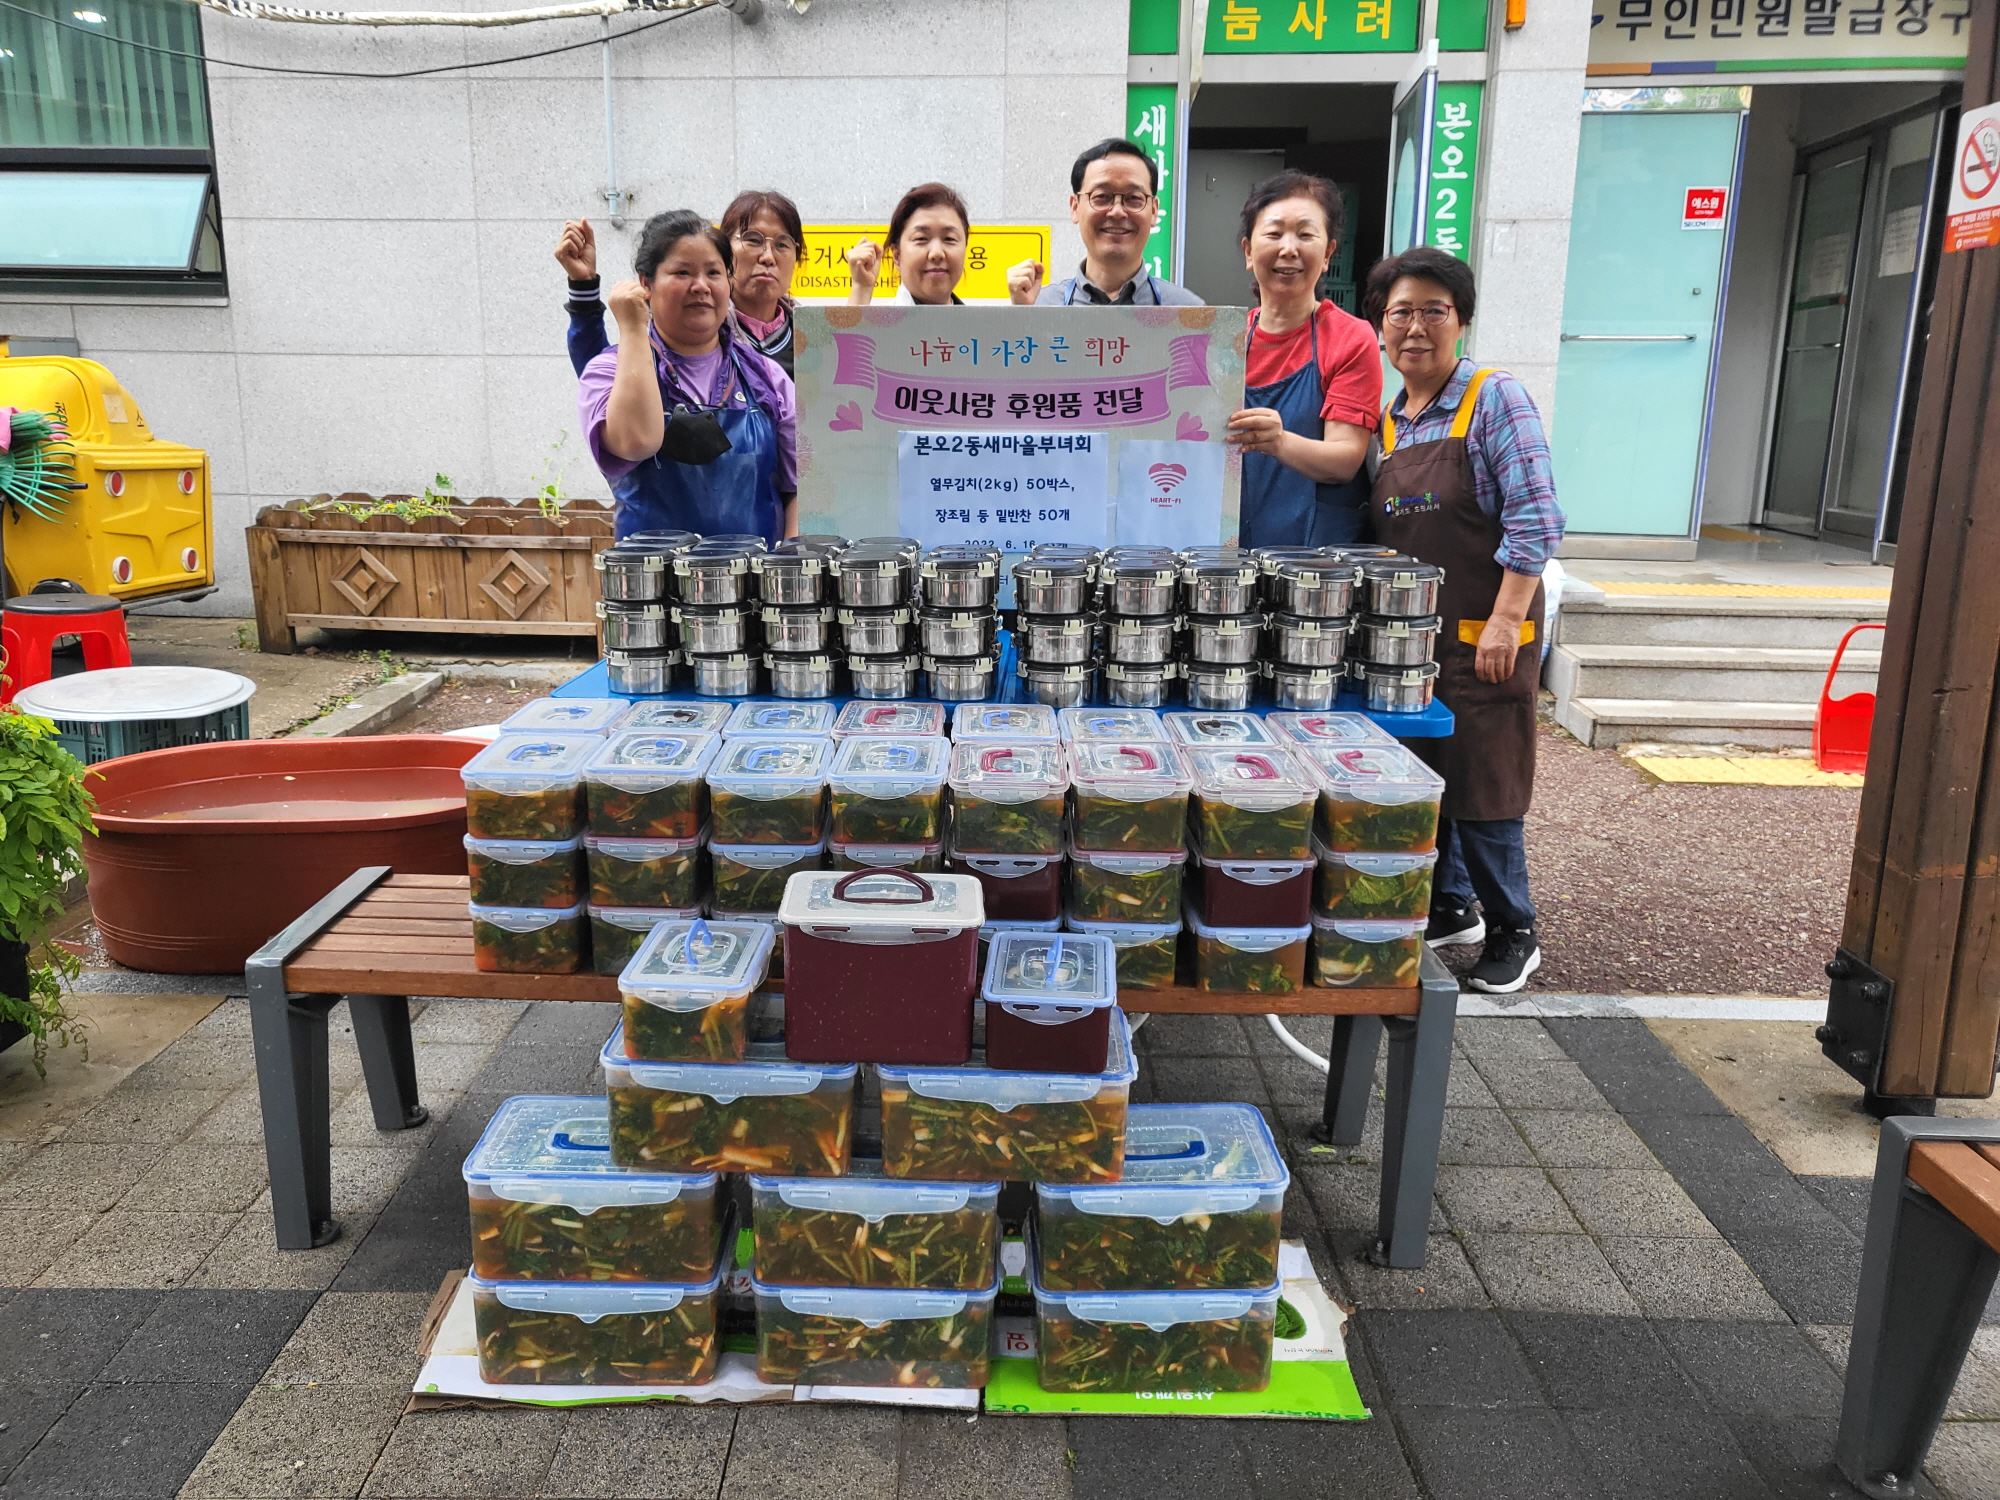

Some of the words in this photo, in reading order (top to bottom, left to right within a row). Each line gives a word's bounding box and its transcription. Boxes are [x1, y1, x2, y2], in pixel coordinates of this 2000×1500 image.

[910, 336, 978, 367] 나눔이
[991, 336, 1039, 368] 가장
[1049, 336, 1070, 363] 큰
[1084, 336, 1131, 367] 희망
[895, 386, 996, 419] 이웃사랑
[1006, 392, 1083, 420] 후원품
[1093, 386, 1144, 416] 전달
[913, 434, 1092, 457] 본오2동새마을부녀회
[930, 477, 1019, 492] 열무김치(2kg)
[1026, 477, 1075, 492] 50박스,
[935, 508, 970, 523] 장조림
[976, 508, 990, 524] 등
[995, 508, 1032, 524] 밑반찬
[1038, 508, 1070, 522] 50개
